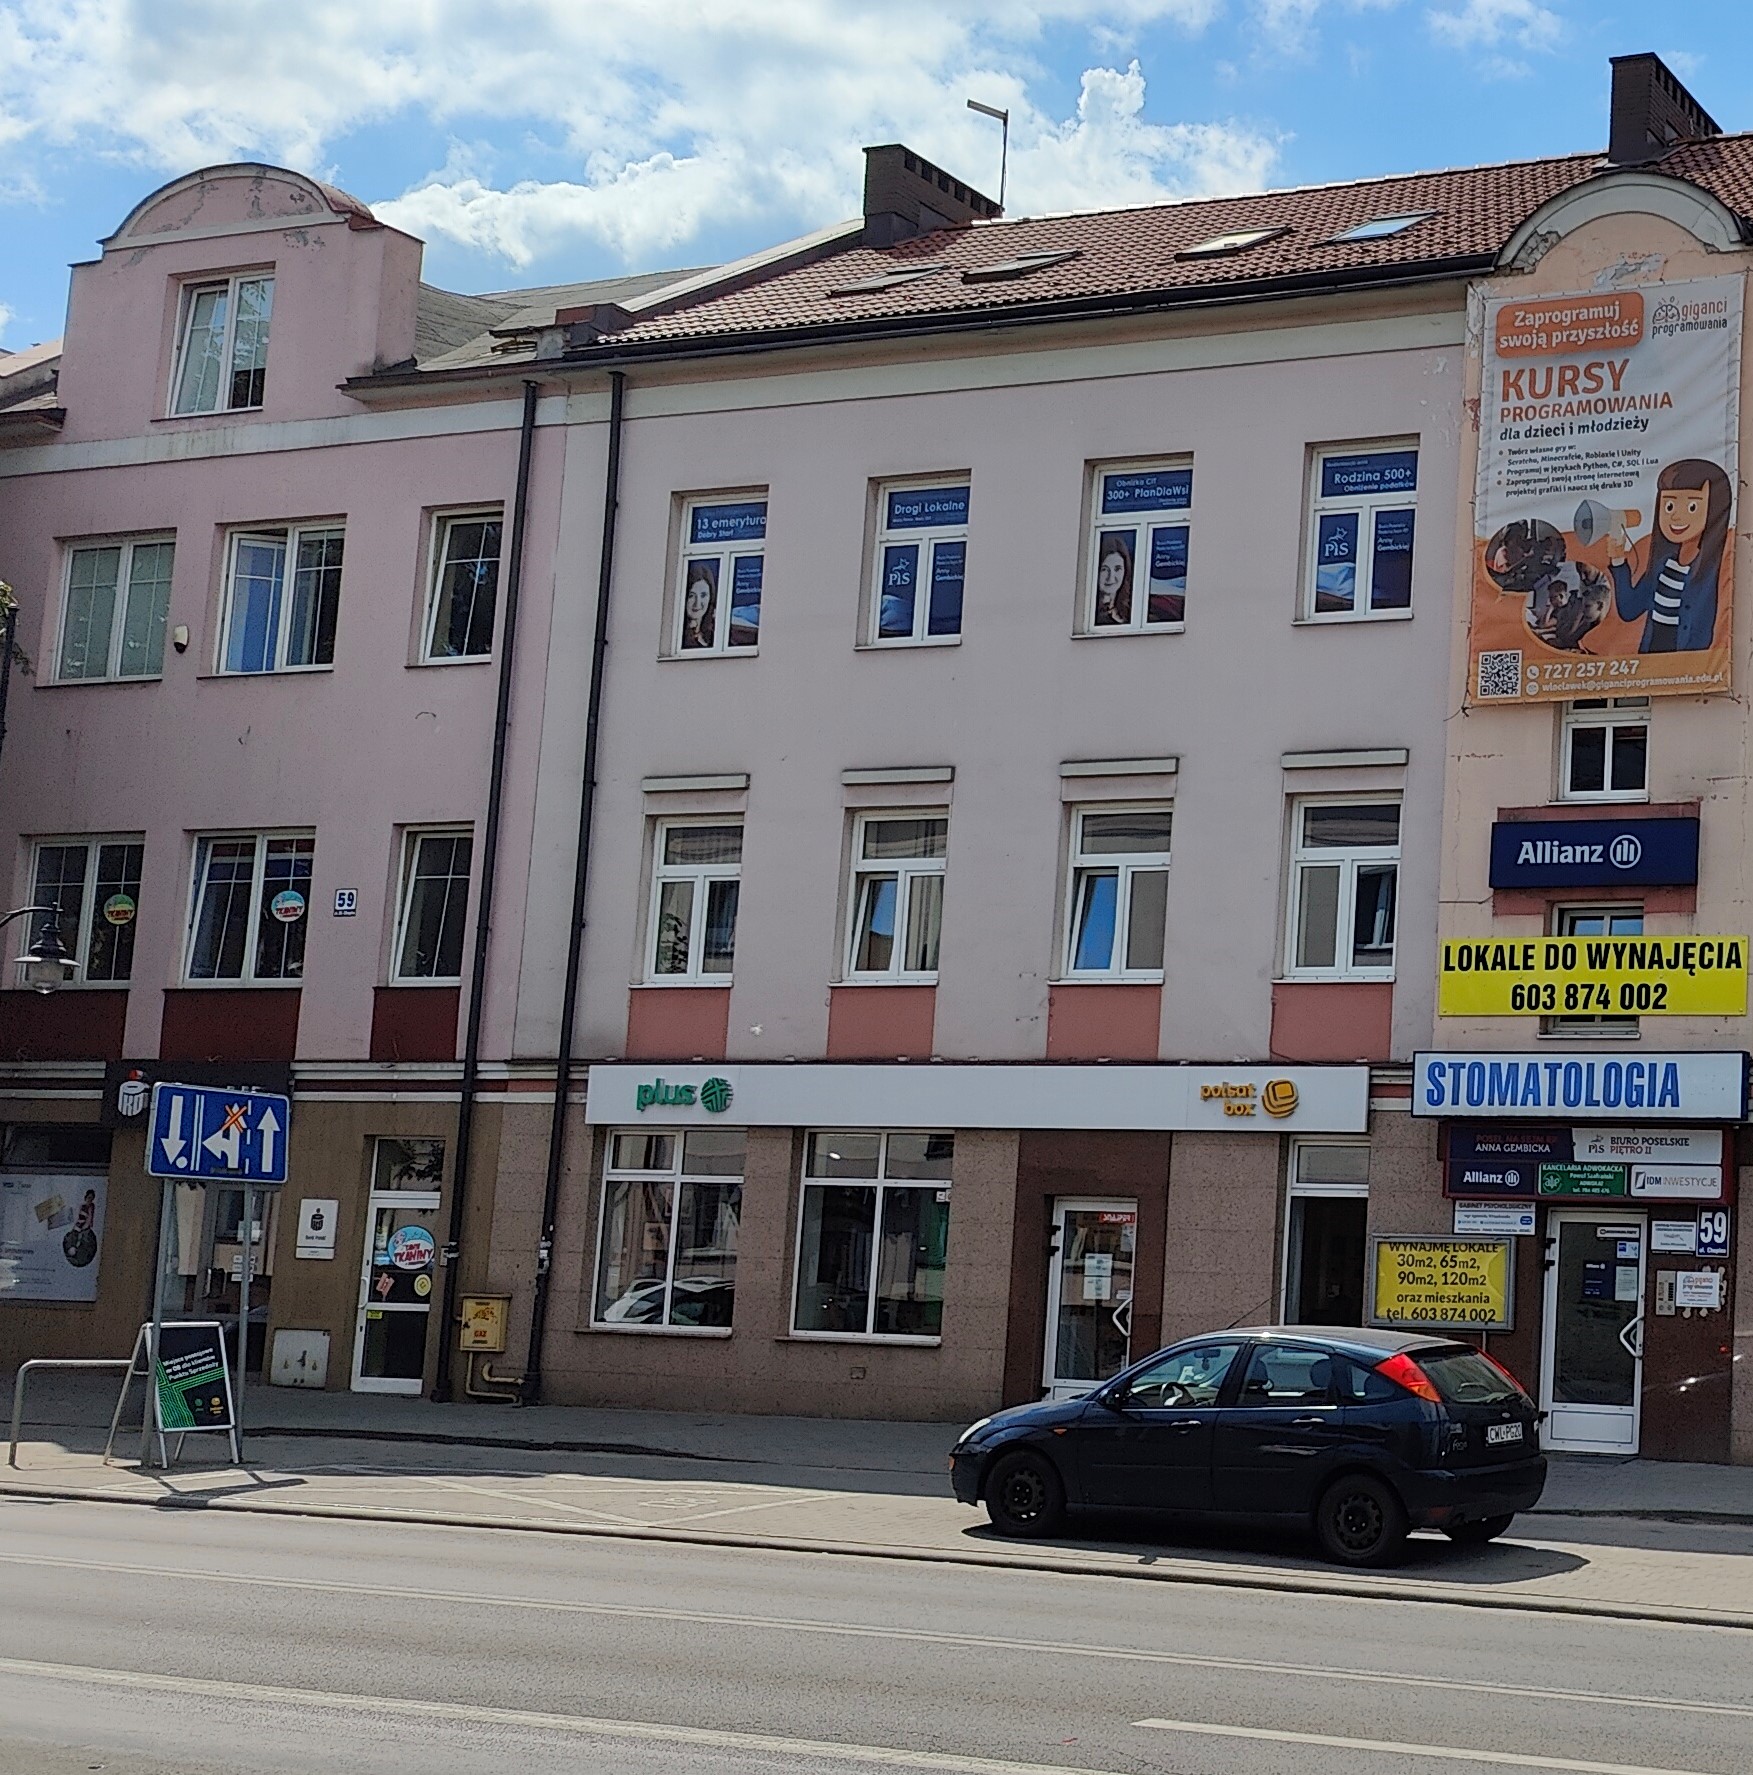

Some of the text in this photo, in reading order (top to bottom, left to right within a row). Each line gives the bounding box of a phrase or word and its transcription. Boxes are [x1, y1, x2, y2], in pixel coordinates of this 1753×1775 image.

[1513, 301, 1620, 328] Zaprogramuj
[1681, 297, 1728, 321] giganci
[1500, 319, 1639, 350] swoją przyszłość
[1652, 317, 1728, 339] programowania
[1501, 358, 1630, 402] KURSY
[1500, 391, 1673, 423] PROGRAMOWANIA
[1499, 415, 1649, 442] dla dzieci i młodzieży
[1507, 448, 1528, 456] Twórz
[1530, 446, 1553, 454] własne
[1554, 445, 1566, 453] gry
[1585, 451, 1615, 460] Robloxie
[1621, 449, 1641, 458] Unity
[1506, 467, 1542, 476] Programuj
[1550, 464, 1581, 474] językach
[1582, 460, 1610, 471] Python,
[1626, 459, 1640, 467] SQL
[1646, 457, 1659, 465] Lua
[1334, 468, 1412, 484] Rodzina 500+
[1506, 470, 1640, 487] Zaprogramuj swoją stronę internetową
[1107, 484, 1189, 501] 300+ PlanDlaWsi
[1380, 480, 1415, 491] podatków
[1505, 487, 1537, 497] projektuj
[1538, 486, 1562, 495] grafiki
[1567, 484, 1588, 492] naucz
[1589, 483, 1600, 492] się
[1601, 481, 1622, 490] druku
[1623, 480, 1634, 489] 3D
[894, 501, 965, 516] Drogi Lokalne
[696, 518, 709, 530] 13
[1543, 660, 1640, 679] 727 257 247
[1517, 841, 1604, 865] Allianz
[337, 892, 355, 908] 59
[1443, 941, 1743, 977] LOKALE DO WYNAJĘCIA
[1511, 983, 1668, 1011] 603 874 002
[1201, 1082, 1257, 1102] polsat
[1426, 1061, 1680, 1109] STOMATOLOGIA
[637, 1077, 698, 1112] plus
[1224, 1099, 1257, 1116] box
[1475, 1143, 1551, 1153] ANNA GEMBICKA
[1610, 1136, 1690, 1147] BIURO POSELSKIE
[1610, 1145, 1652, 1156] PIĘTRO II
[1583, 1164, 1624, 1172] ADWOKACKA
[1463, 1170, 1503, 1184] Allianz
[1646, 1177, 1718, 1188] IDM INWESTYCJE
[1700, 1211, 1728, 1244] 59
[393, 1248, 433, 1263] TKANINY
[1389, 1242, 1498, 1254] WYNAJMĘ LOKALE
[1397, 1253, 1481, 1271] 30m2, 65m2,
[1397, 1271, 1487, 1287] 90m2, 120m2
[1396, 1292, 1490, 1304] oraz mieszkania
[1386, 1307, 1496, 1322] tel. 603 874 002
